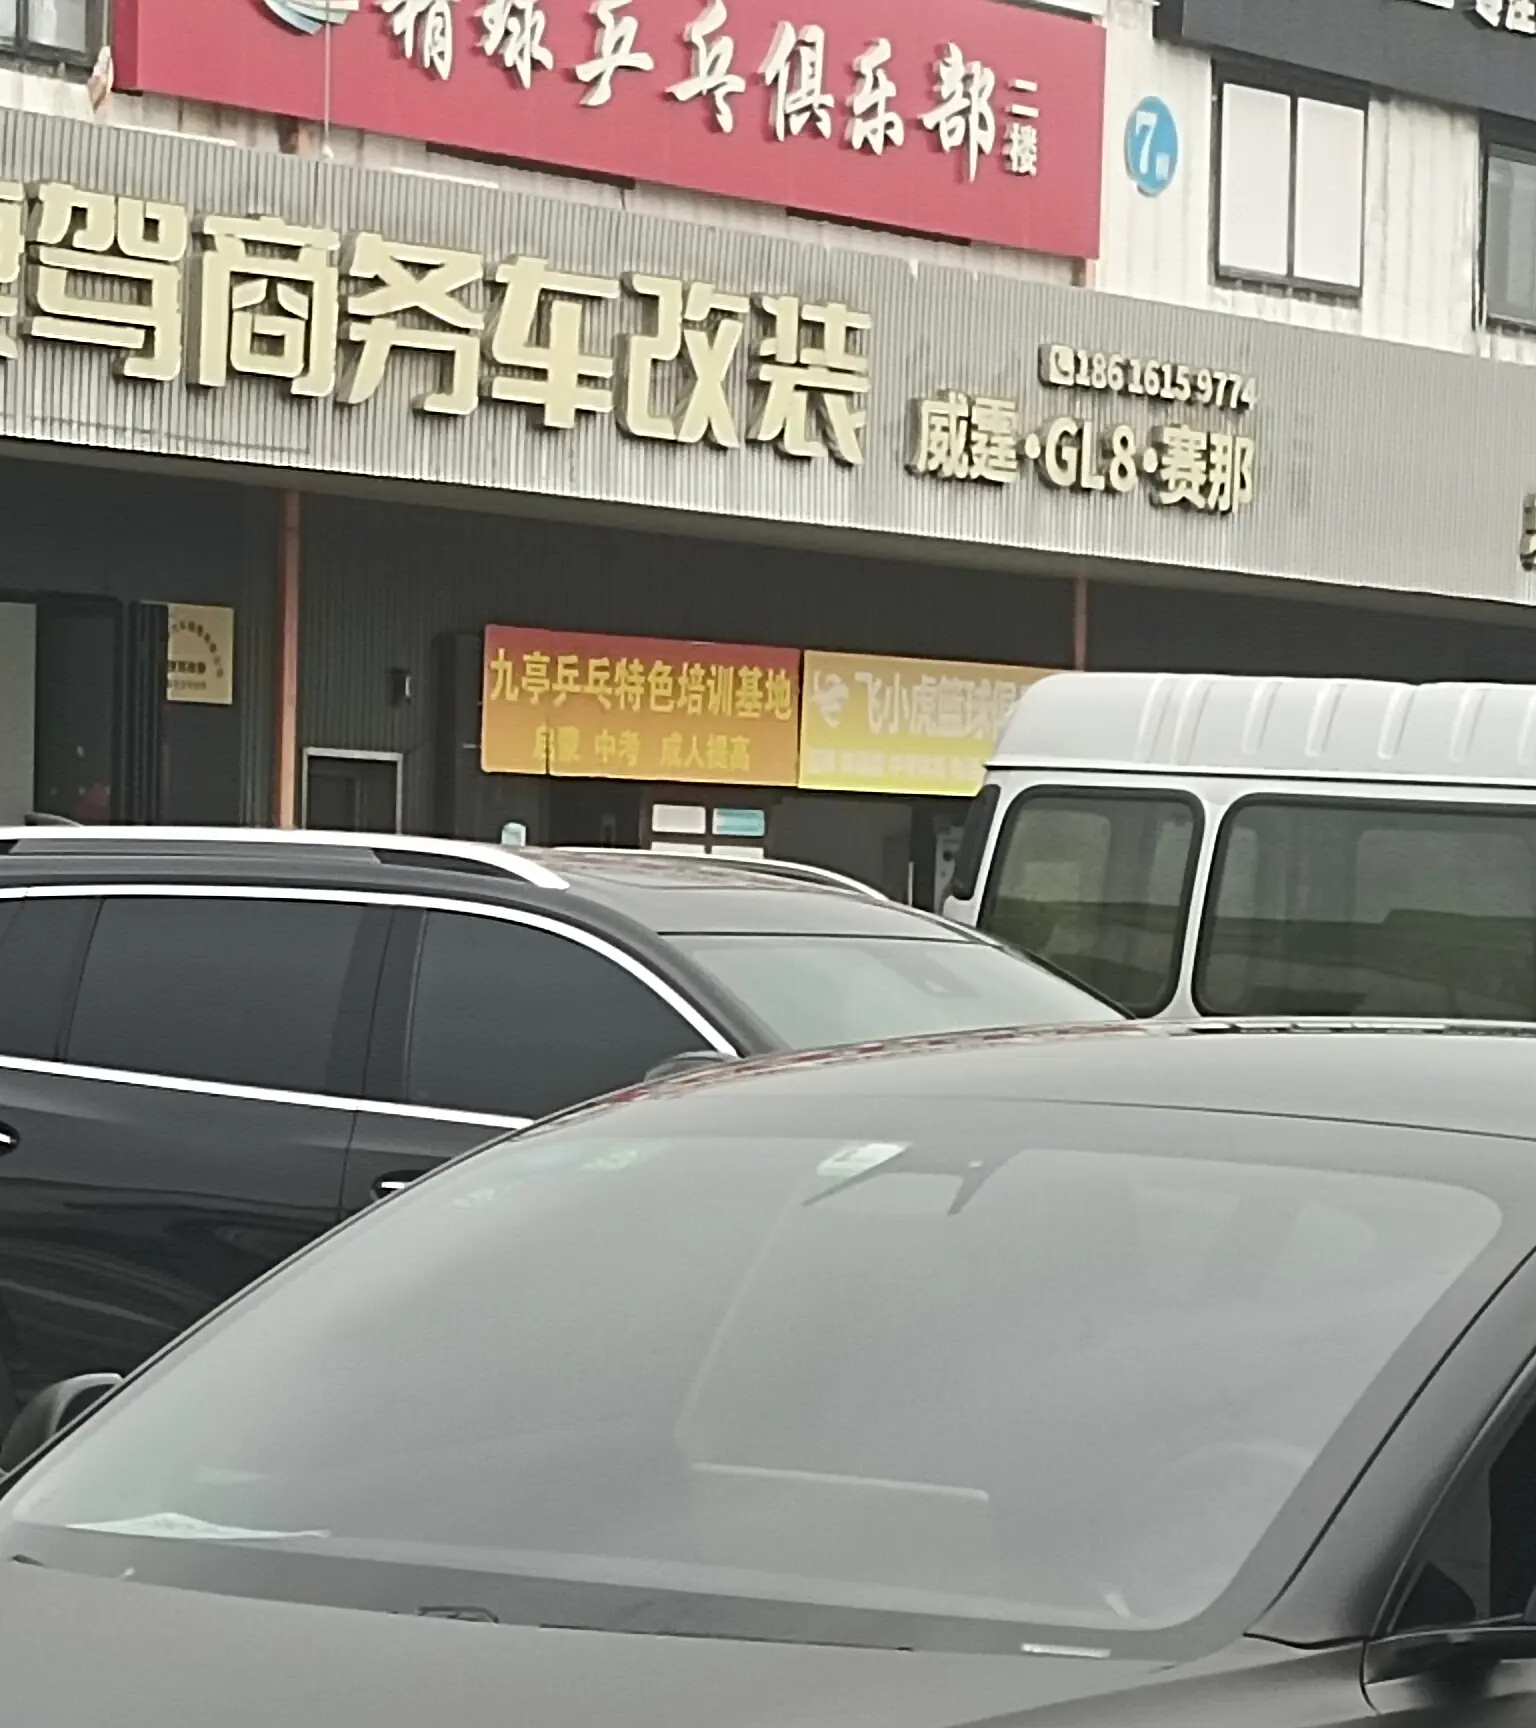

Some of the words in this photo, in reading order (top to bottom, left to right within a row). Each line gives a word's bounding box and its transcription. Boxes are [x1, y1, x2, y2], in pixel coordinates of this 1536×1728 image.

[1011, 78, 1040, 176] 二楼
[490, 648, 792, 721] 九亭乒乓特色培训基地
[595, 729, 641, 767] 中考
